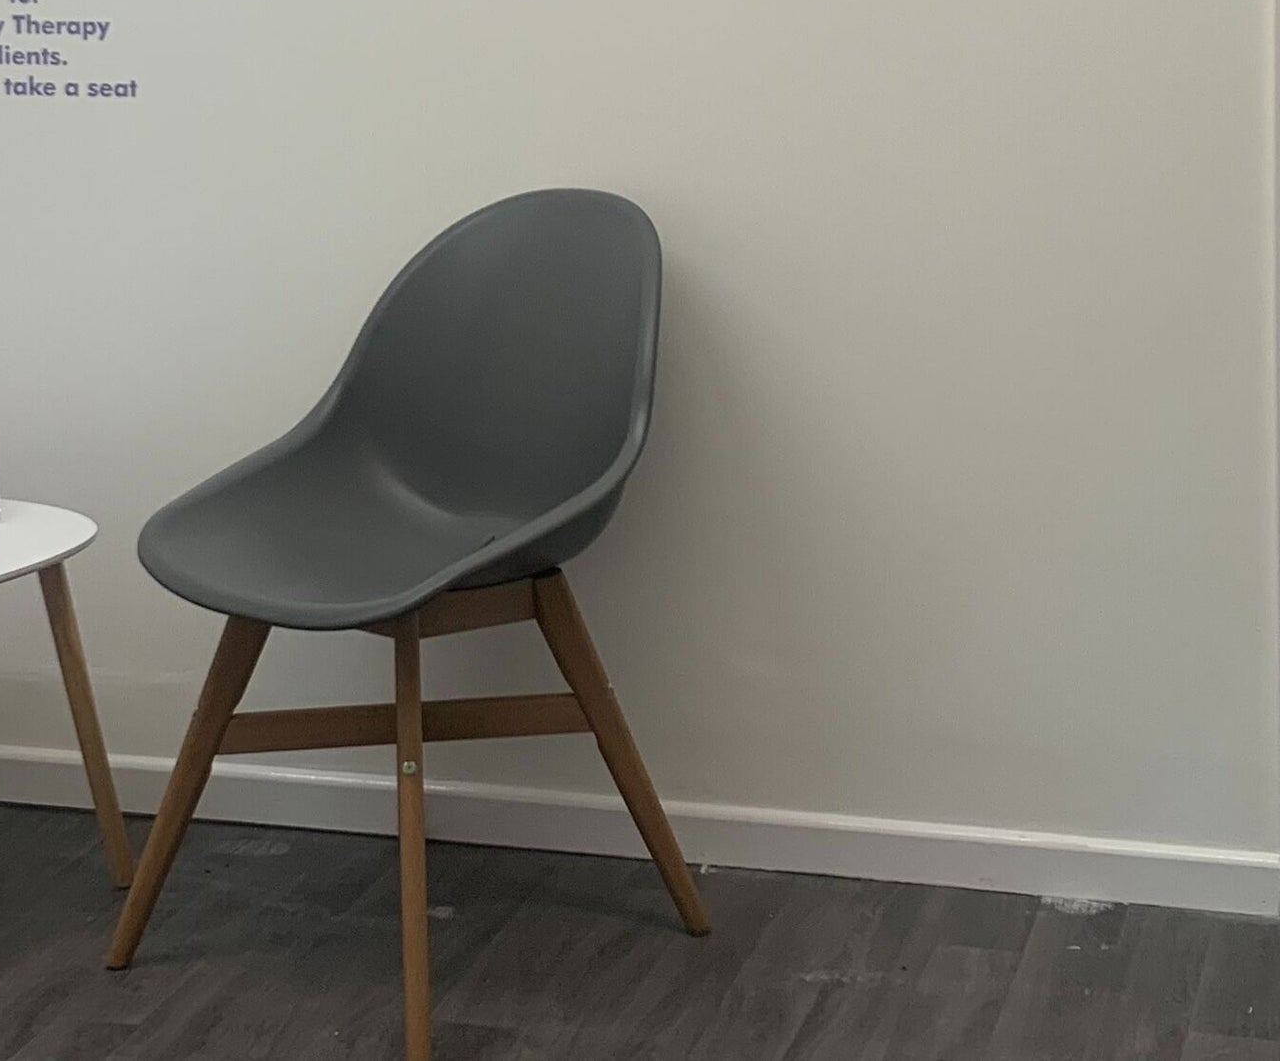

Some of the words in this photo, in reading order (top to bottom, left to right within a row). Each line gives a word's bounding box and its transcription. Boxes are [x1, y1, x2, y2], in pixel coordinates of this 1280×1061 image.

[11, 15, 111, 40] Therapy
[4, 76, 56, 96] take
[64, 81, 79, 96] a
[87, 80, 138, 98] seat
